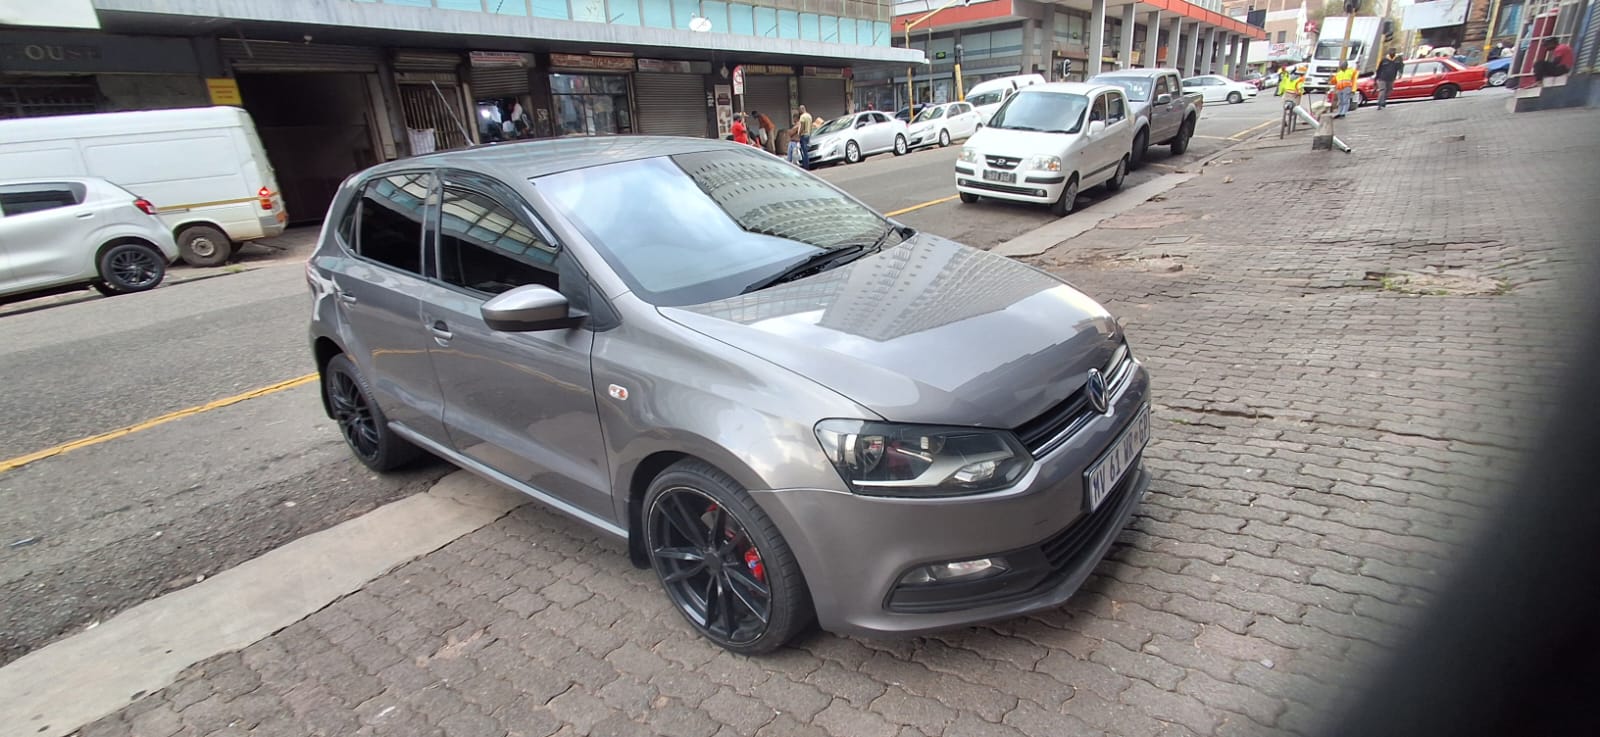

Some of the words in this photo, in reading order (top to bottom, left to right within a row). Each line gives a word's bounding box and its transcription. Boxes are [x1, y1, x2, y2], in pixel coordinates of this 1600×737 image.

[1093, 463, 1106, 504] MV
[1110, 447, 1121, 482] 61
[1138, 413, 1148, 443] GP
